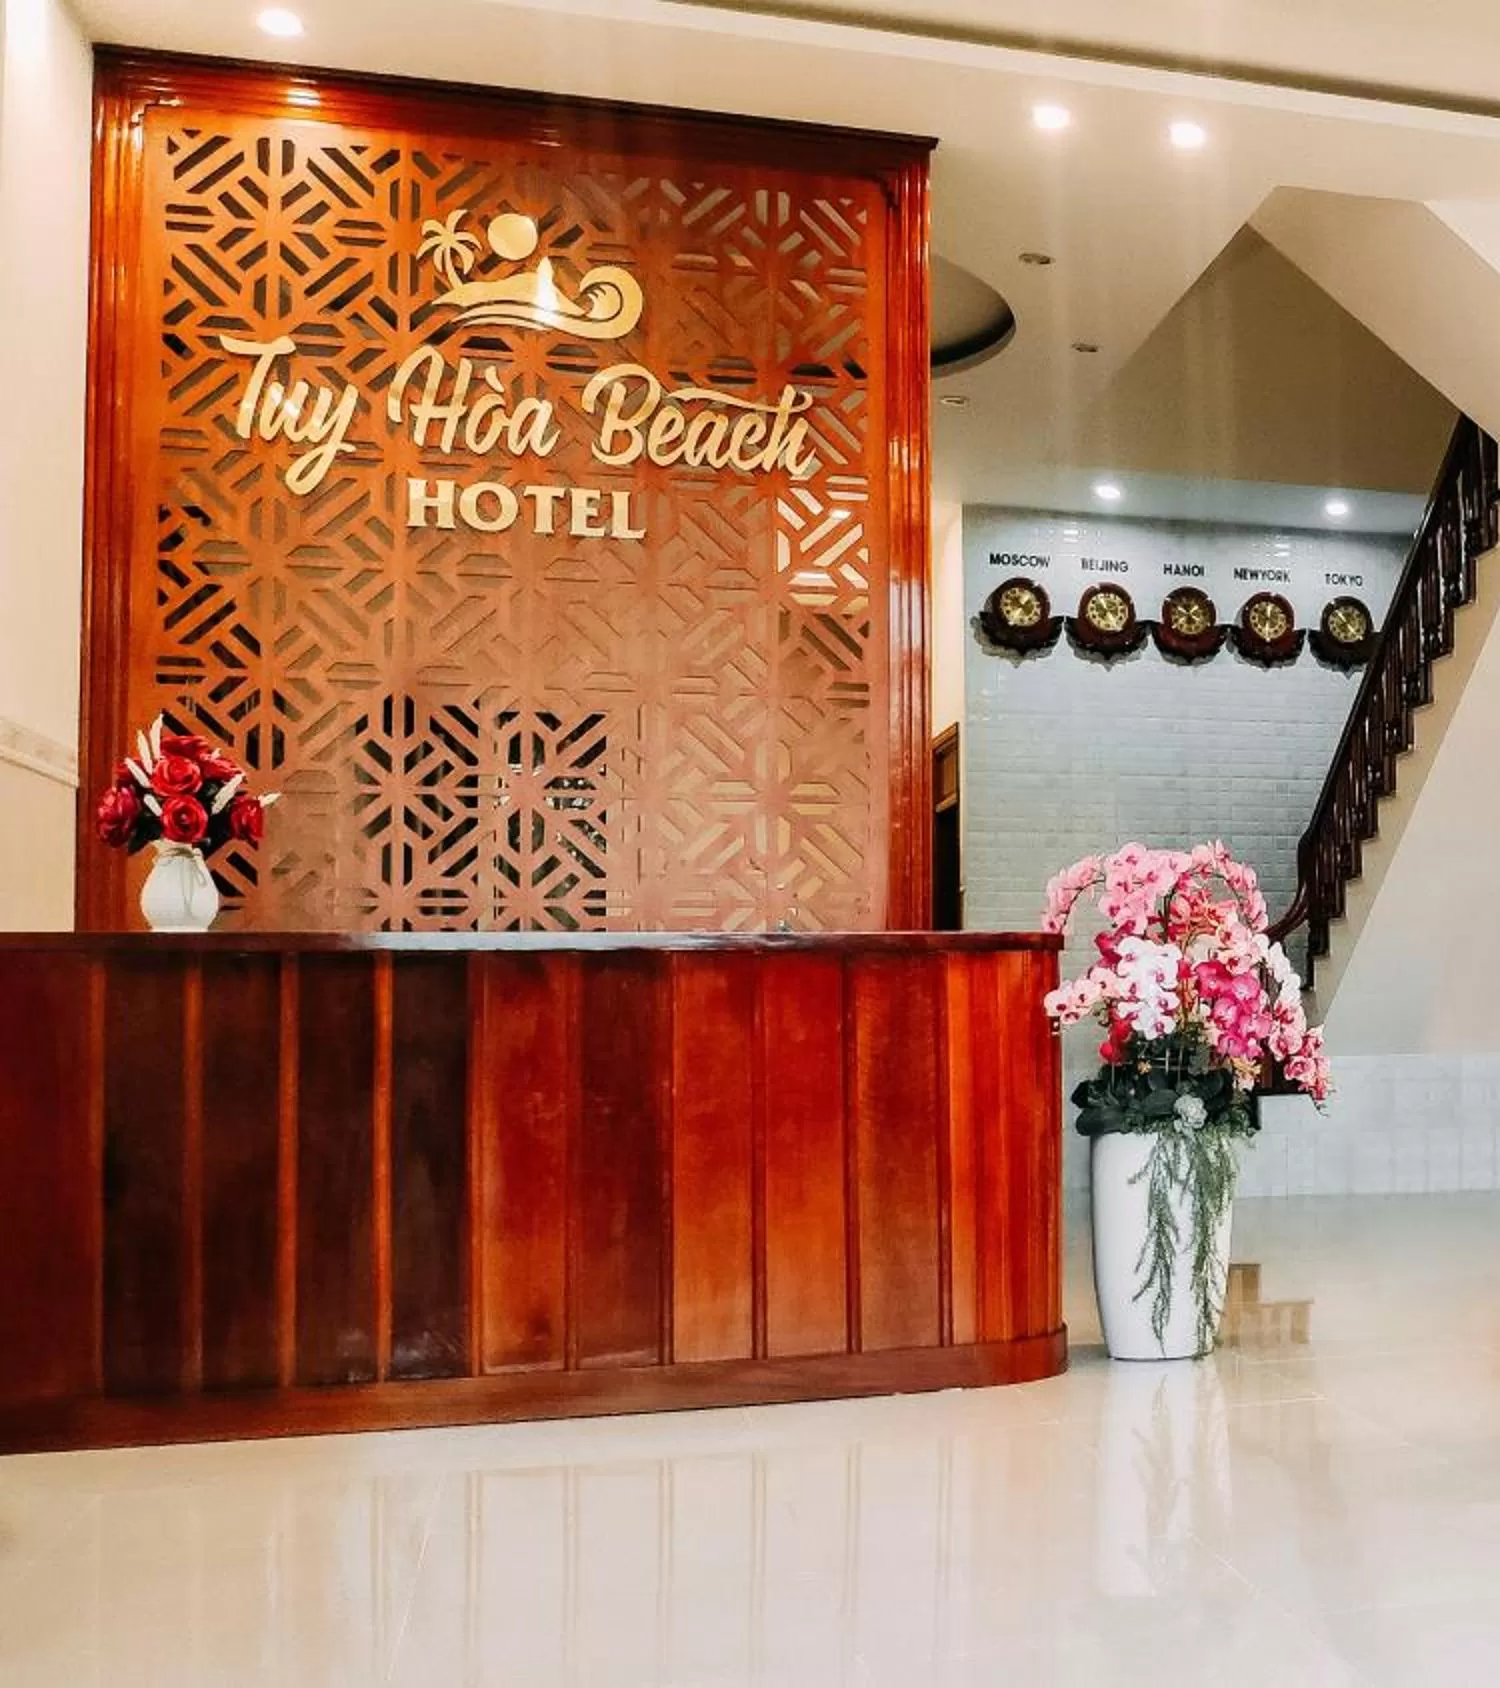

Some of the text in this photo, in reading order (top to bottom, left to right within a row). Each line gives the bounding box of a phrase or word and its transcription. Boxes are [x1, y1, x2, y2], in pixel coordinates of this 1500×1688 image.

[219, 334, 817, 496] Tuy Hòa Beach
[405, 477, 646, 540] HOTEL
[989, 553, 1050, 568] MOSCOW
[1081, 557, 1129, 573] BEIJING
[1163, 563, 1205, 577] HANOI
[1324, 573, 1363, 587] TOKYO
